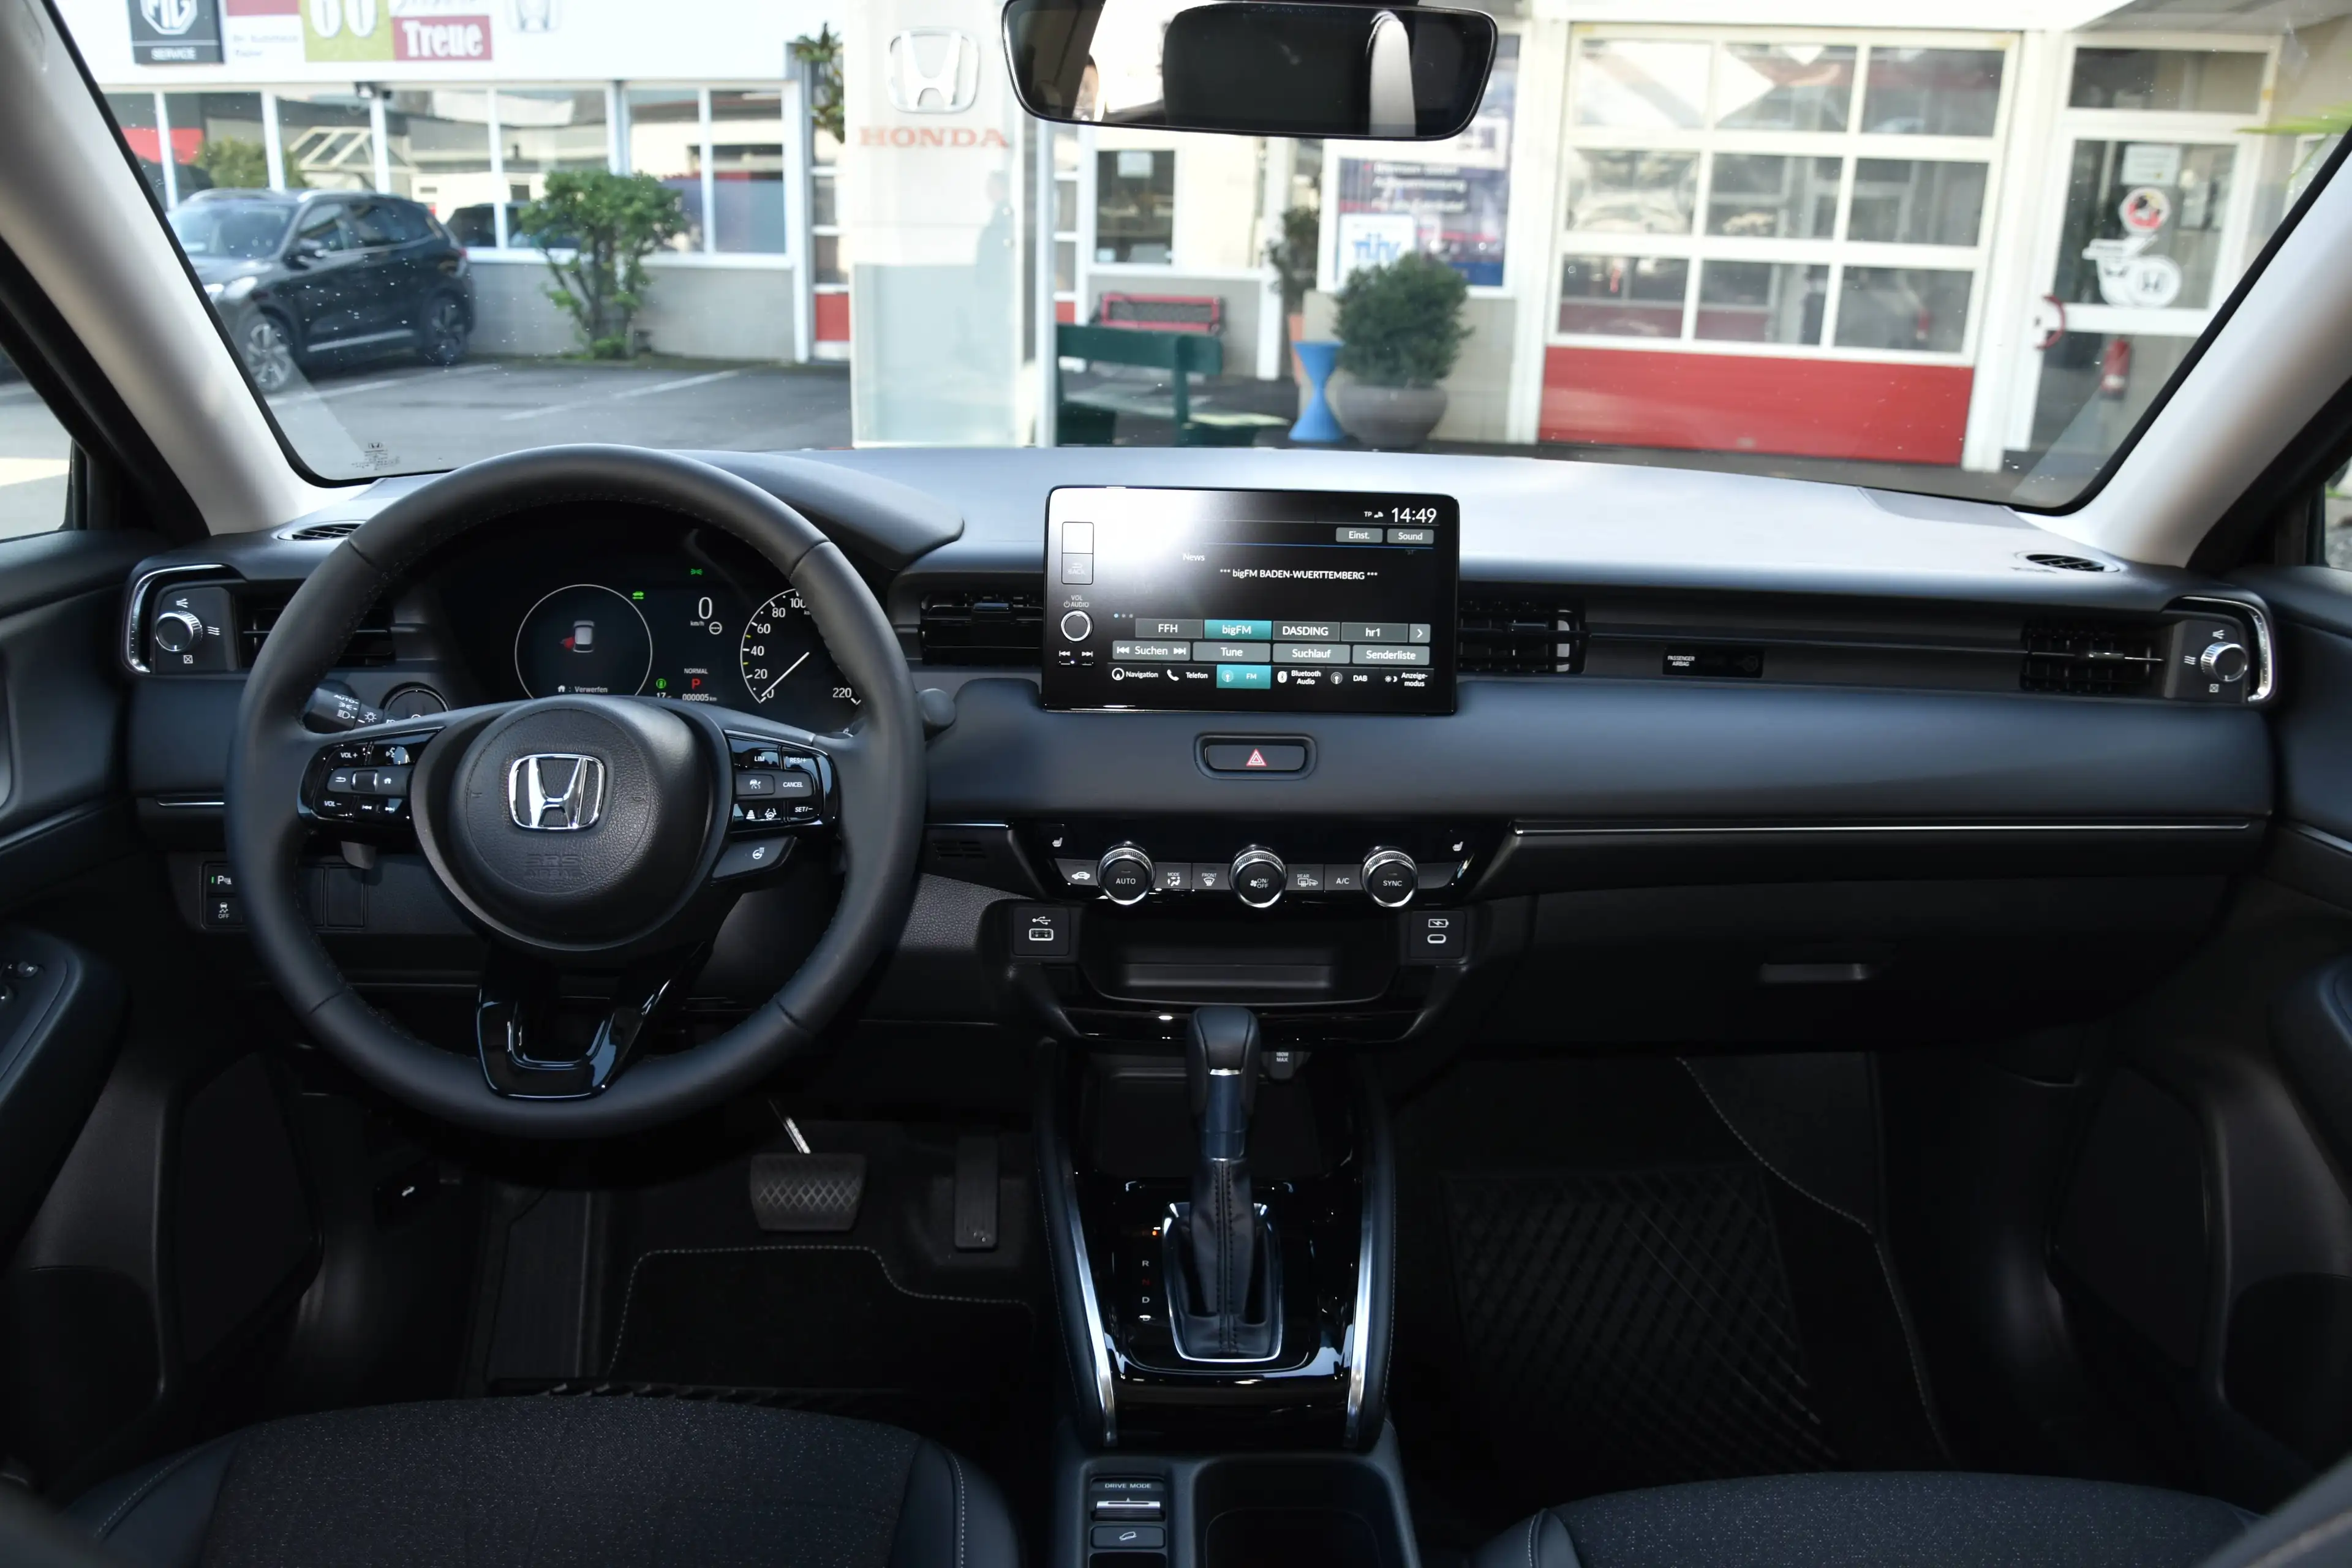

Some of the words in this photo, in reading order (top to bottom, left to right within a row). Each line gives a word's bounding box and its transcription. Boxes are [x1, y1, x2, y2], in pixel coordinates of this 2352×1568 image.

[402, 20, 484, 57] Treue
[151, 47, 195, 60] SERVICE
[859, 127, 1010, 148] HONDA
[1391, 507, 1437, 524] 14:49
[1348, 530, 1370, 540] Einst.
[1398, 532, 1423, 541] Sound
[1183, 553, 1205, 562] News
[1232, 568, 1257, 579] bigFM
[1259, 569, 1365, 580] BADEN-WUERTTEMBERG
[698, 597, 712, 619] 0
[772, 608, 786, 617] 80
[757, 624, 771, 633] 60
[1158, 624, 1178, 633] FFH
[1222, 625, 1251, 635] bigFM
[1282, 626, 1329, 636] DASDING
[1365, 628, 1381, 637] hr1
[750, 646, 764, 656] 40
[1134, 646, 1168, 655] Suchen
[1221, 647, 1243, 657] Tune
[1292, 649, 1331, 658] Suchlauf
[1366, 650, 1416, 660] Senderliste
[754, 669, 767, 679] 20
[1401, 672, 1428, 680] Anzeige-
[692, 679, 701, 689] P
[832, 687, 852, 698] 220
